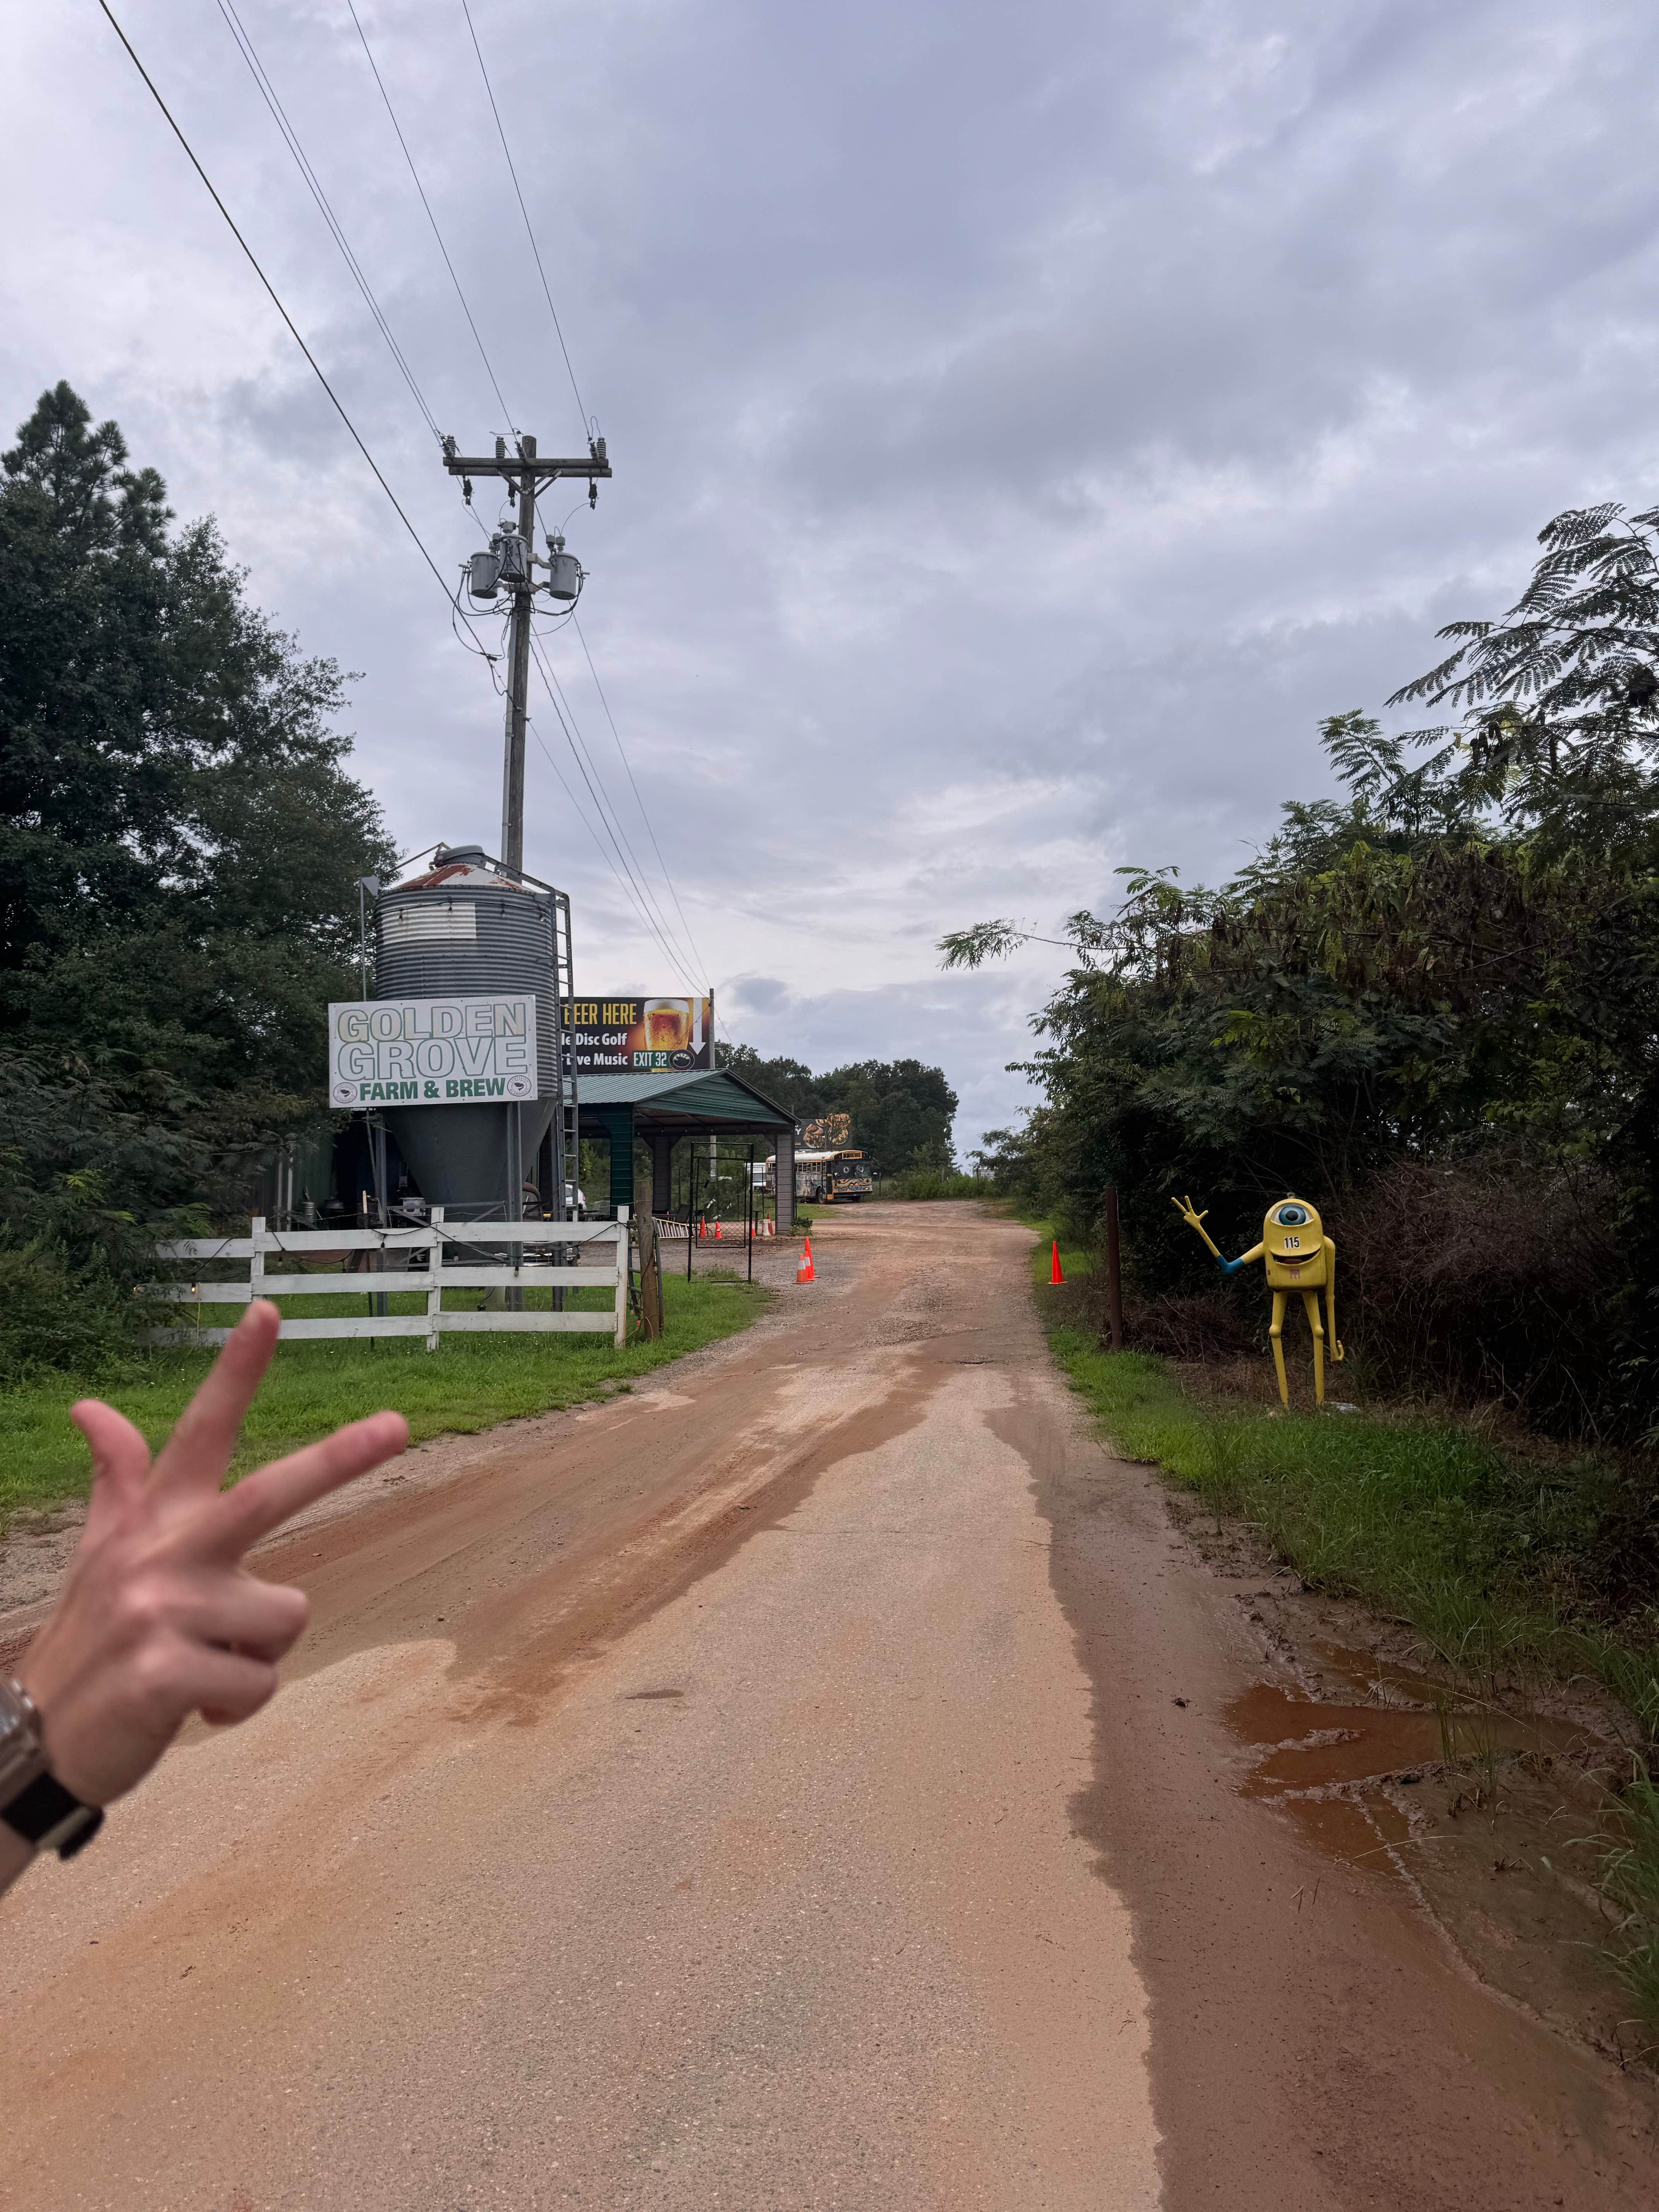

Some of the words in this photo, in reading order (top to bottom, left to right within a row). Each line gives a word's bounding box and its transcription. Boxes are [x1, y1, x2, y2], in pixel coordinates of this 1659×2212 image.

[338, 1003, 526, 1043] GOLDEN
[603, 1003, 637, 1025] HERE
[576, 1032, 600, 1045] Disc
[602, 1032, 628, 1045] Golf
[338, 1035, 528, 1082] GROVE
[567, 1053, 591, 1065] Lve
[593, 1052, 628, 1065] Music
[633, 1052, 653, 1066] EXIT
[655, 1052, 667, 1066] 32
[360, 1081, 418, 1101] FARM
[423, 1080, 441, 1098] &
[446, 1077, 506, 1098] BREW
[1284, 1237, 1300, 1248] 115
